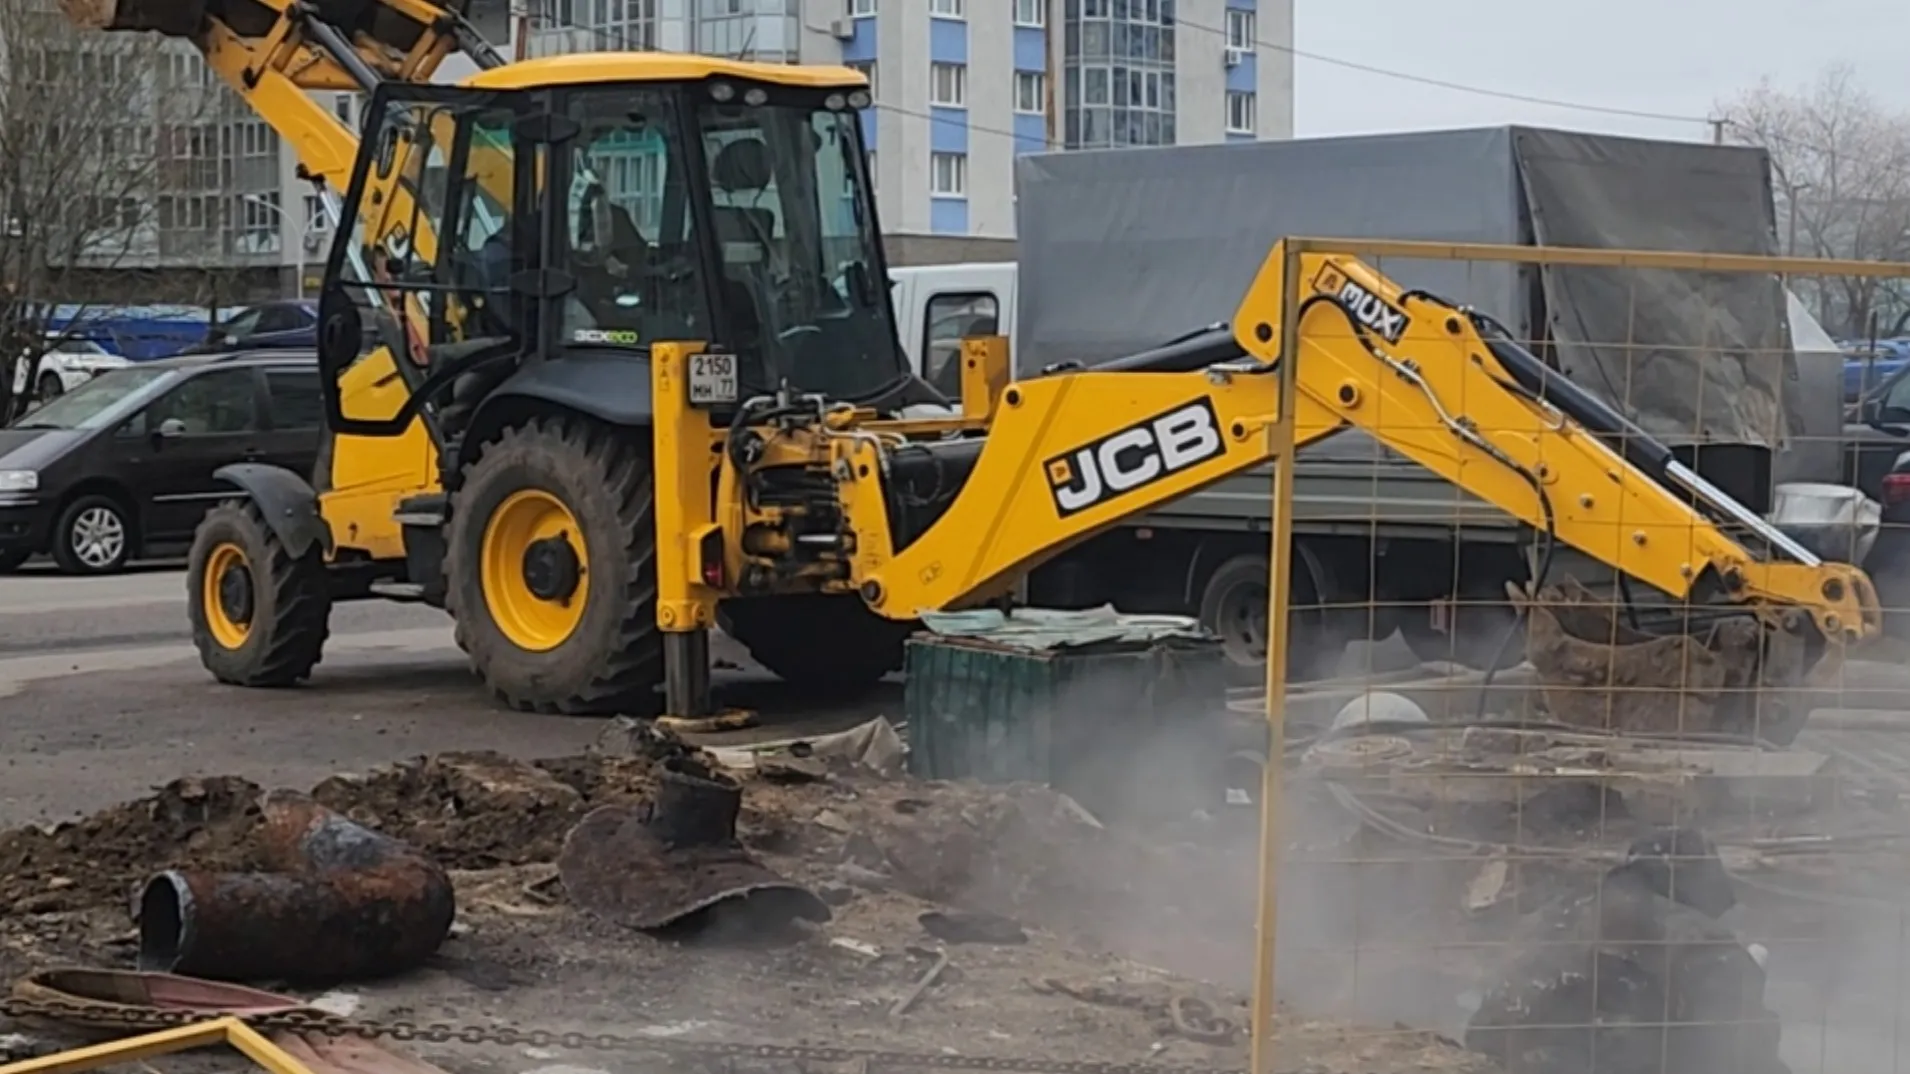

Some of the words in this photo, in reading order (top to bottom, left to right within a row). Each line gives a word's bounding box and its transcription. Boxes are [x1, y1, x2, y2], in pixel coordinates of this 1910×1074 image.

[695, 357, 732, 376] 2150
[720, 378, 733, 394] 77
[1056, 403, 1220, 511] JCB
